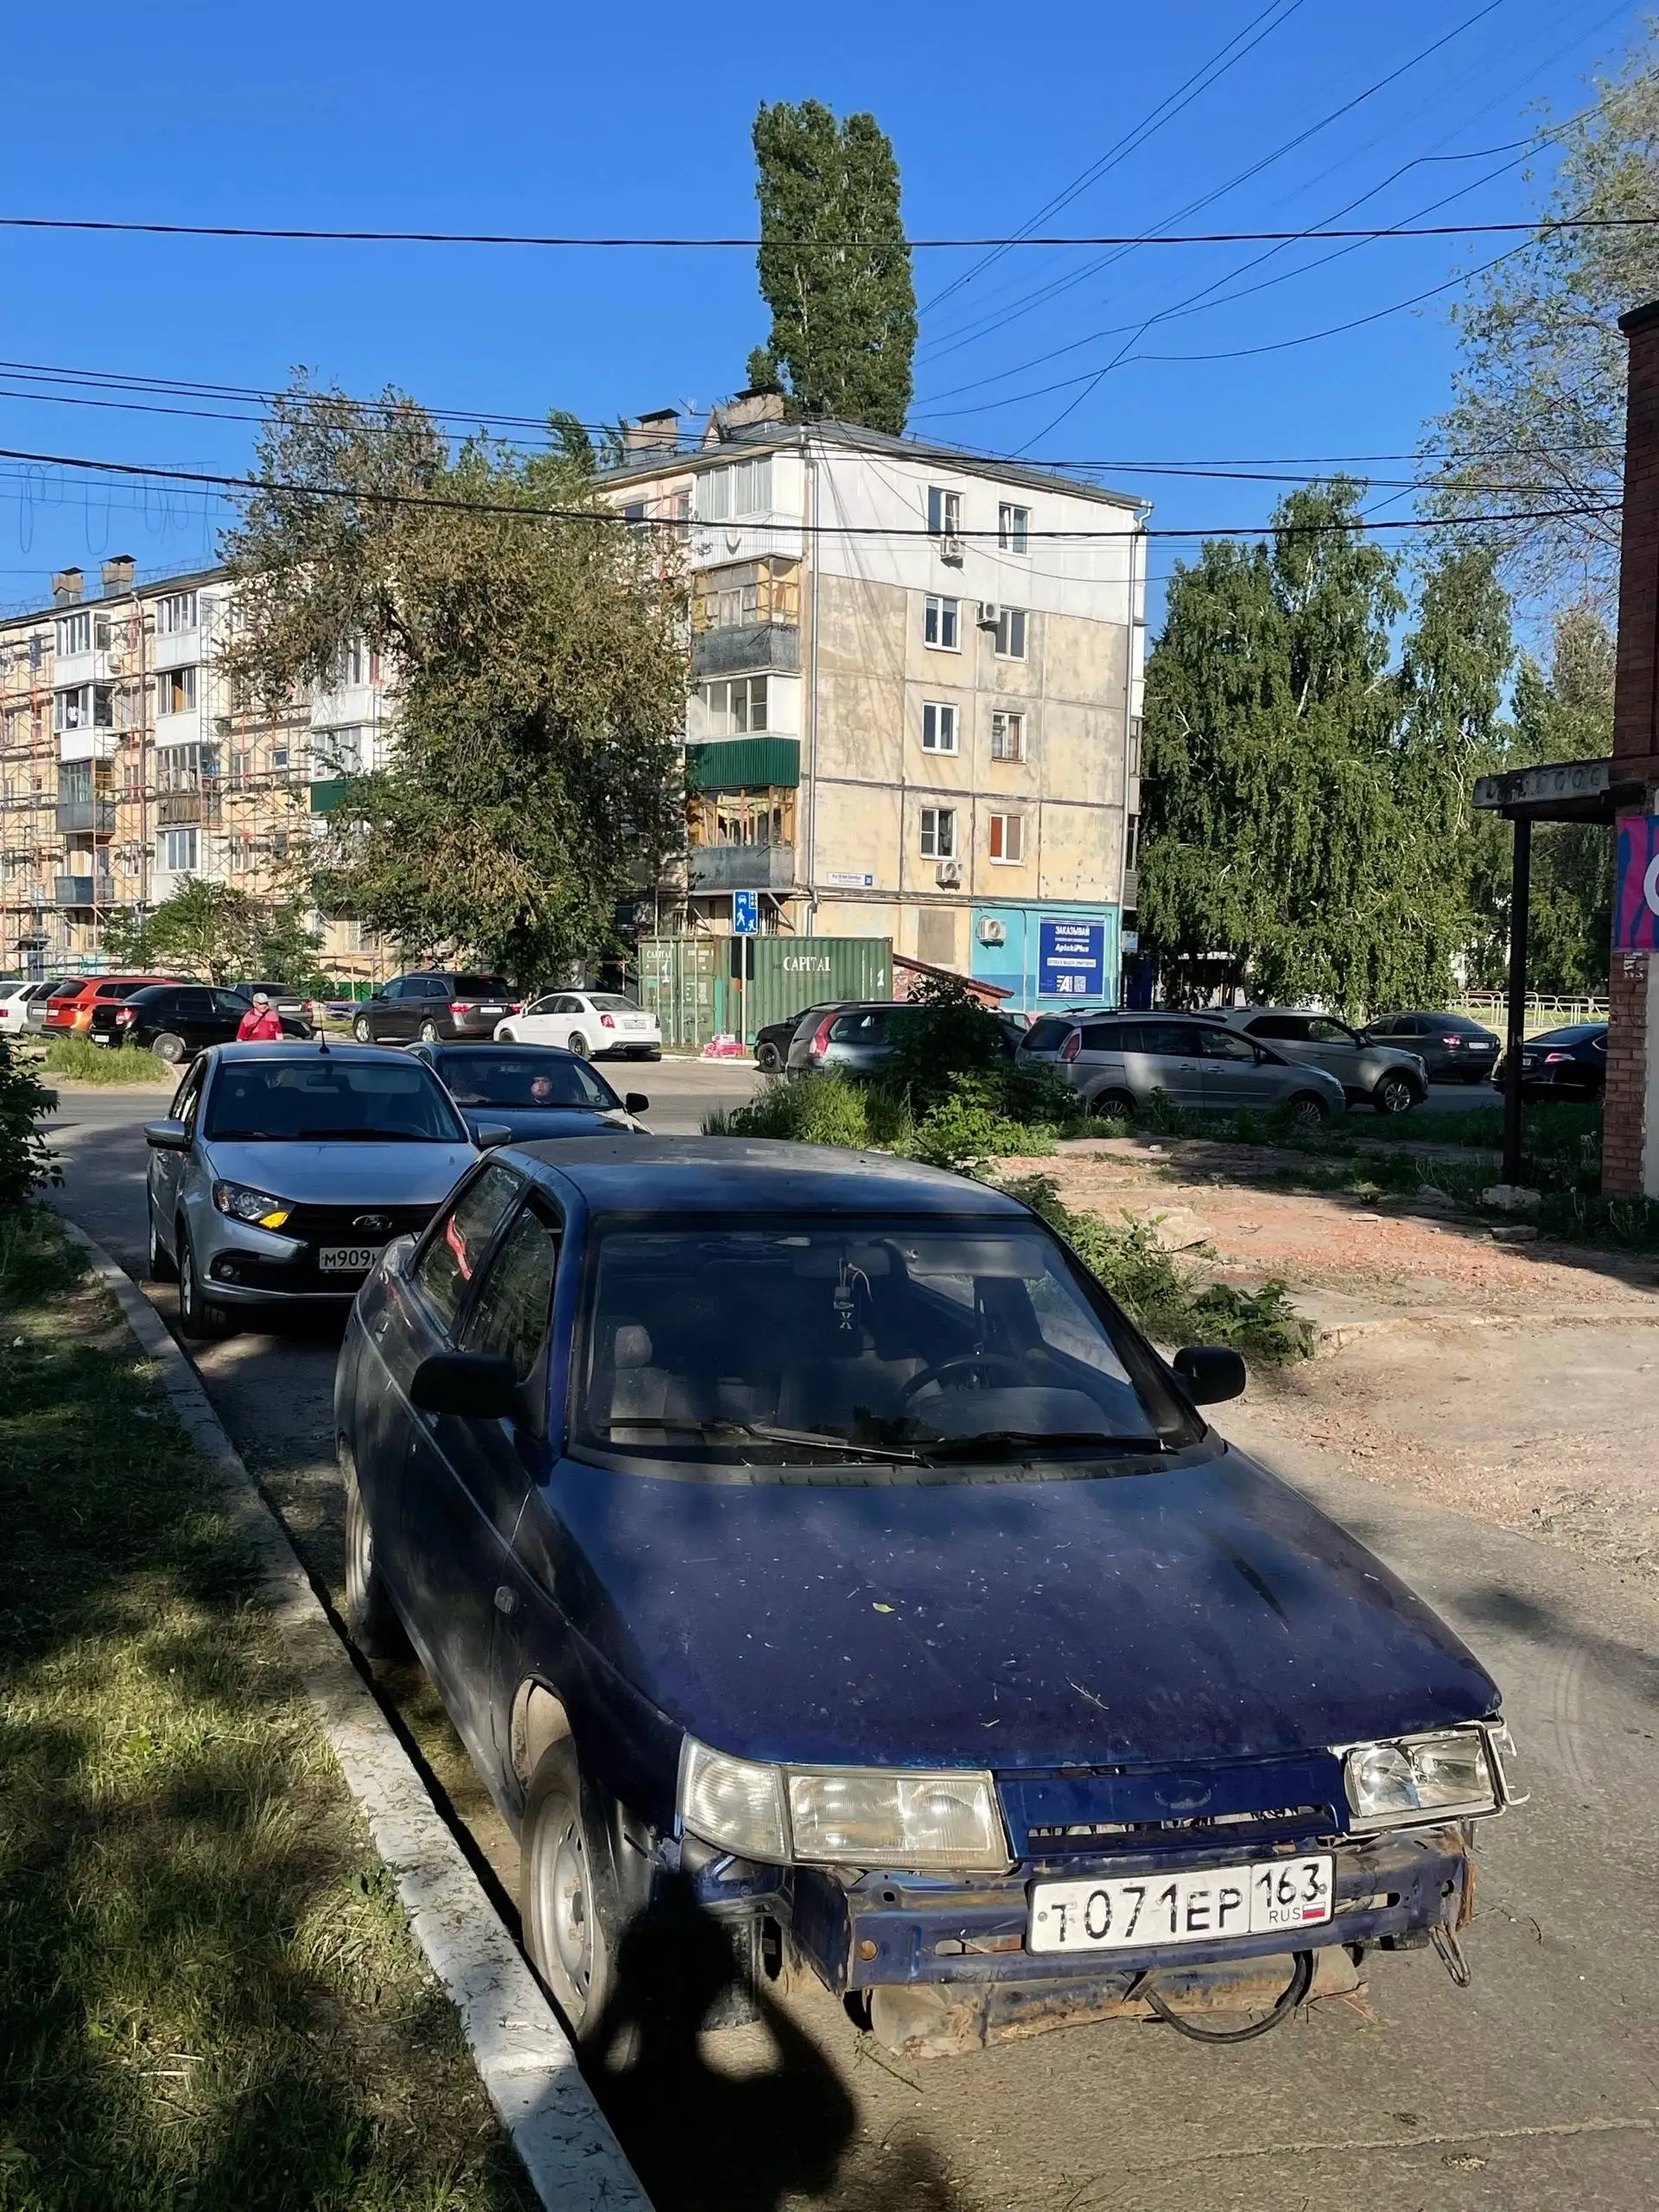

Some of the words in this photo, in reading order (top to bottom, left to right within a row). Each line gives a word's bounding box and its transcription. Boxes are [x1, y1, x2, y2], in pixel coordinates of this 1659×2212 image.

[1054, 925, 1090, 937] ЗАКАЗЫВАЙ
[783, 957, 831, 971] CAPITAL
[1255, 1862, 1322, 1908] 163
[1268, 1907, 1301, 1924] RUS
